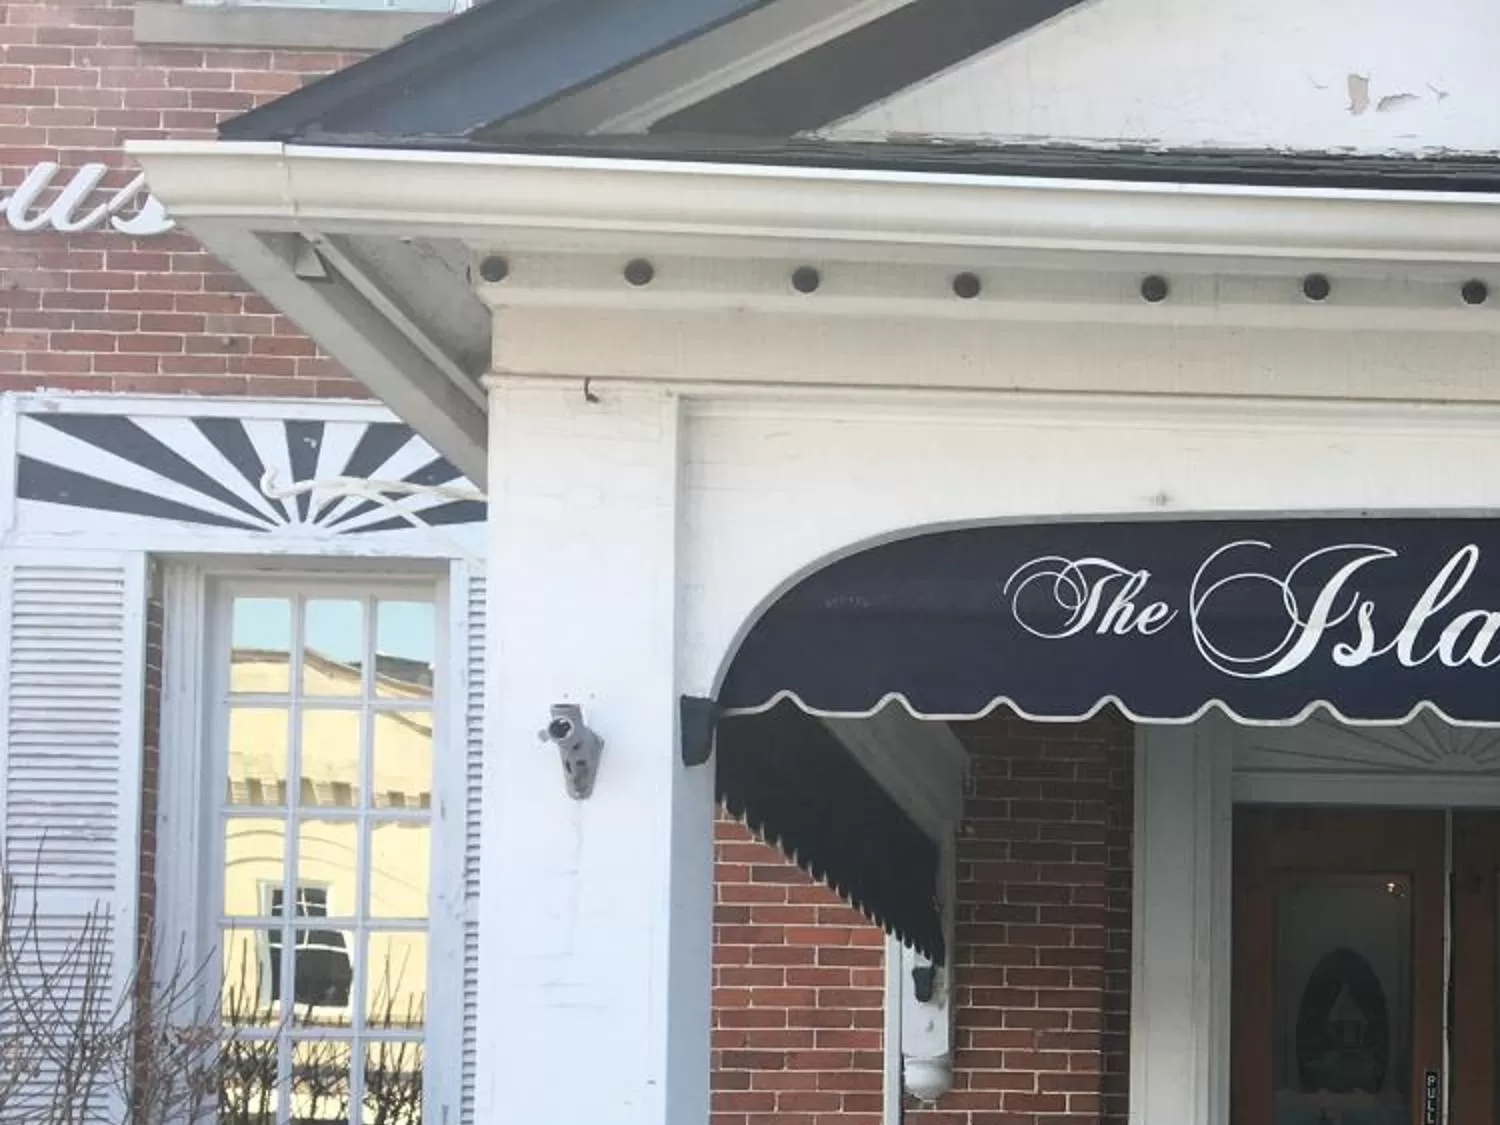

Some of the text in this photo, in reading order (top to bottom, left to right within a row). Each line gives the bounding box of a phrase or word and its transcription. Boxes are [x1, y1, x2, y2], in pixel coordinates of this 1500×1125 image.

[0, 161, 177, 235] us
[1002, 555, 1178, 639] The
[1427, 1074, 1437, 1125] PULL
